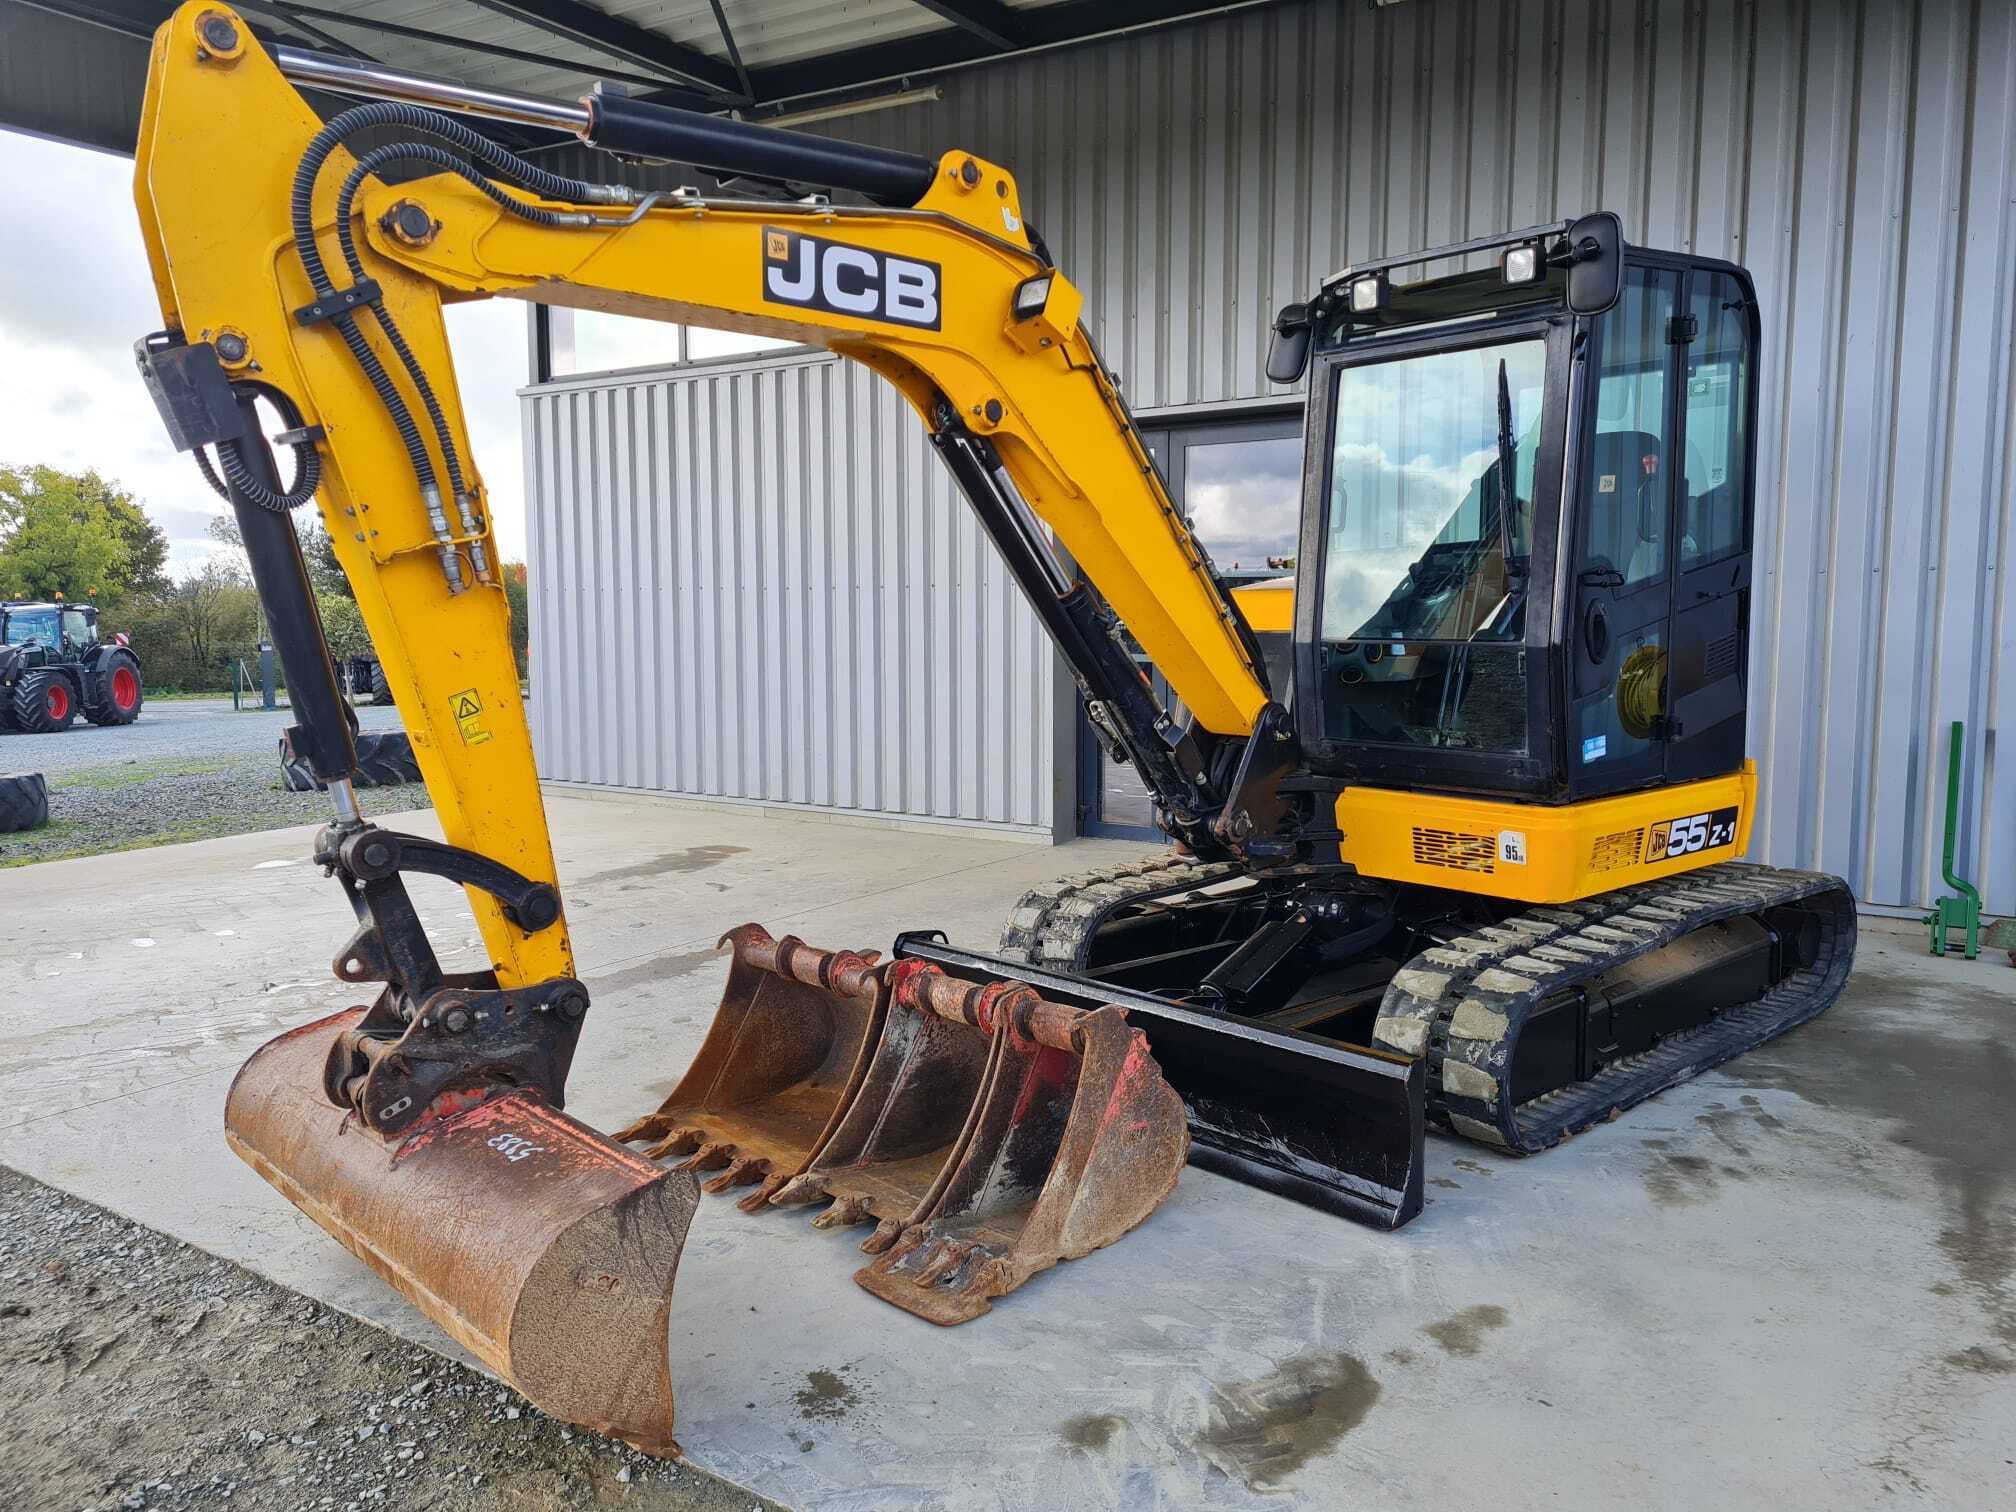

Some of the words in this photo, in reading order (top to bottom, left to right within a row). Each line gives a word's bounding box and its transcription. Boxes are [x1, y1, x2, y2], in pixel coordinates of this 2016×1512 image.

[767, 238, 938, 324] JCB
[1505, 844, 1518, 861] 95
[1667, 813, 1709, 857] 55
[1708, 821, 1735, 847] Z-1
